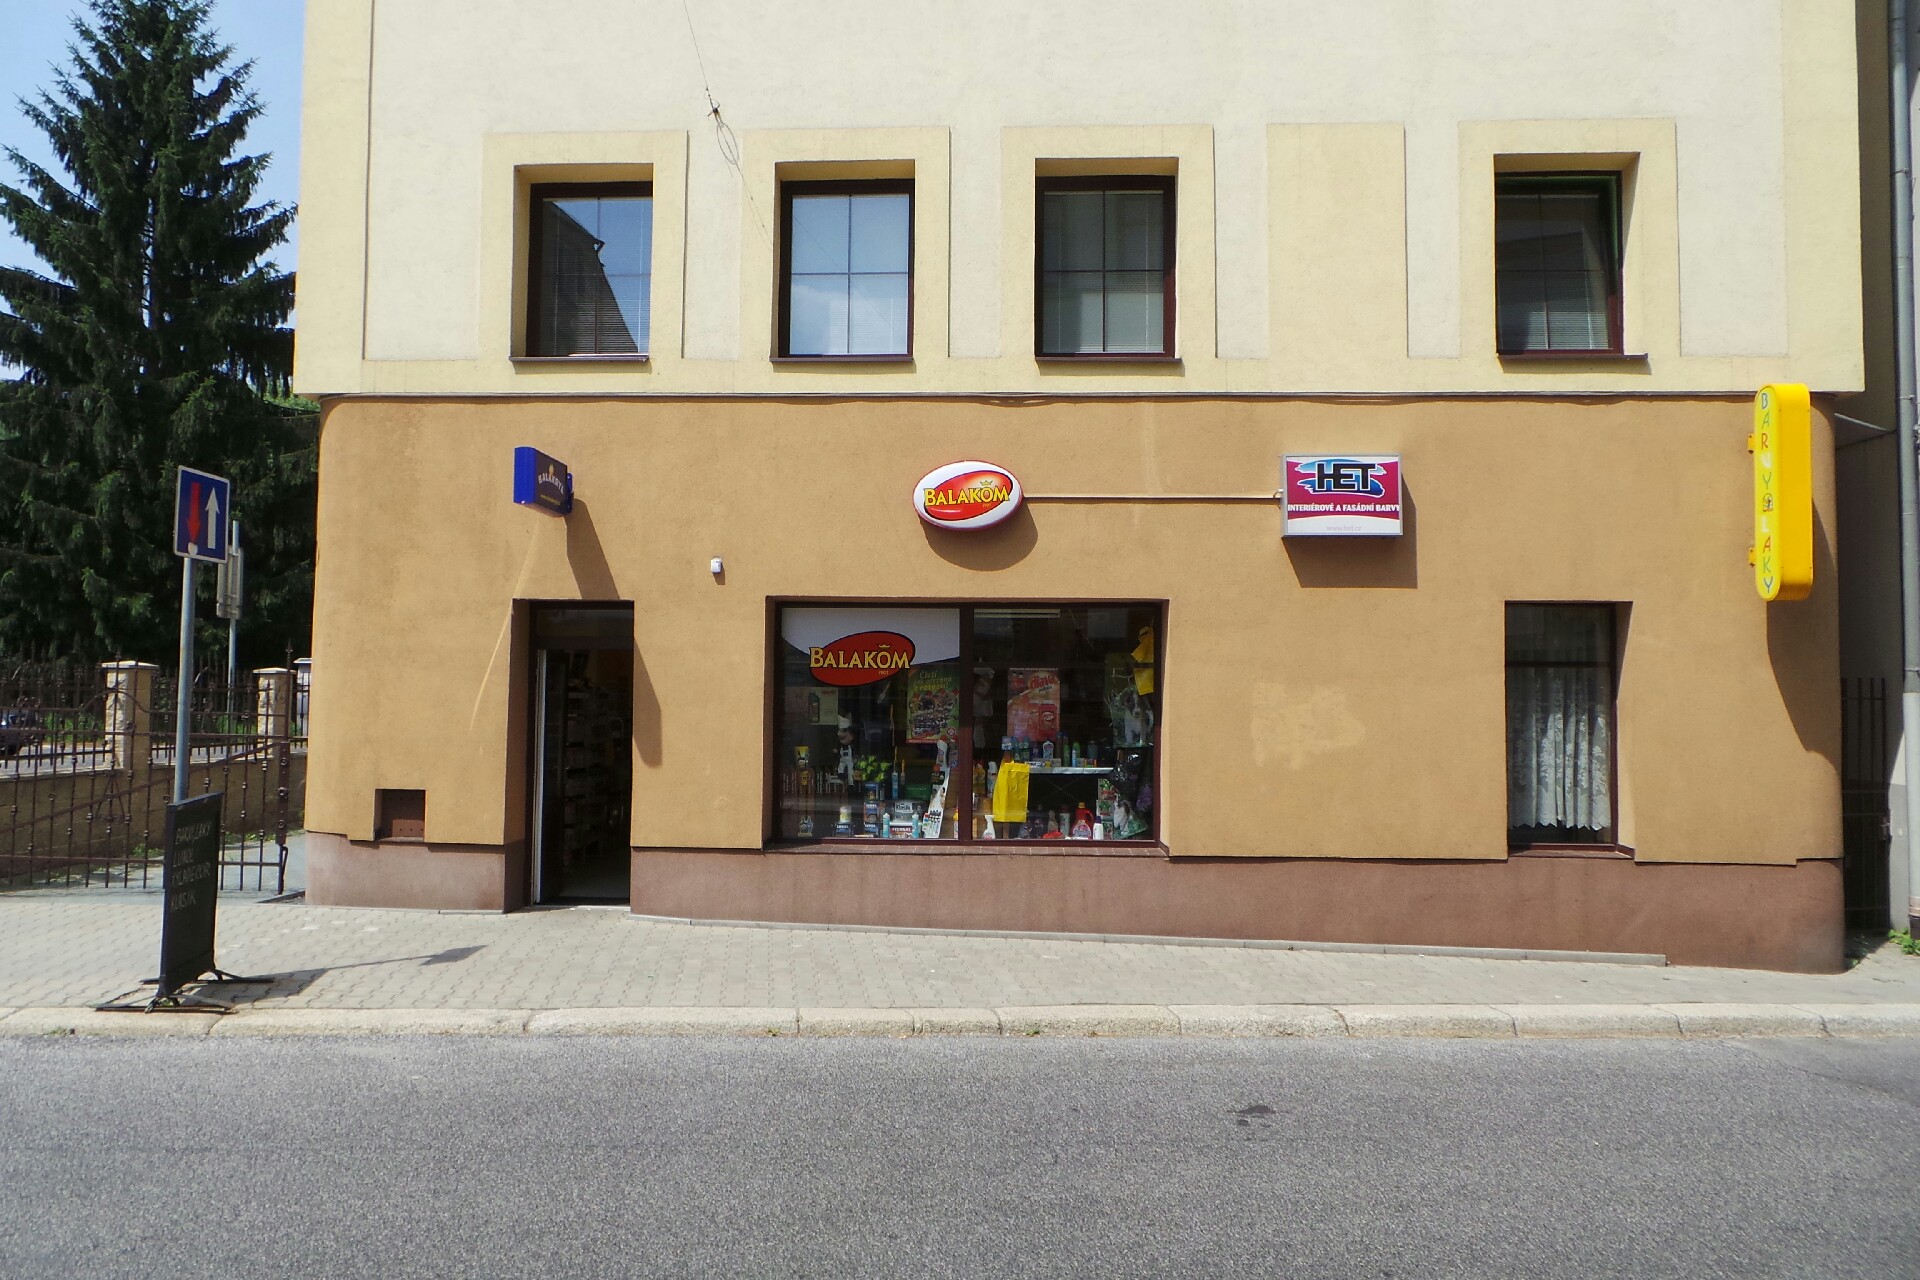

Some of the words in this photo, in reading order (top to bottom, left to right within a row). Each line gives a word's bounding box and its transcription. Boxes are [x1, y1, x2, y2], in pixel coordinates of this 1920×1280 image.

[1316, 462, 1376, 490] HET
[923, 484, 1010, 506] BALAKOM
[1287, 502, 1334, 512] INTERIÉROVÉ
[1335, 503, 1342, 512] A
[1342, 502, 1375, 512] FASÁDNÍ
[1375, 503, 1400, 512] BARVY
[1760, 515, 1774, 594] LAKY
[809, 646, 910, 669] BALAKOM
